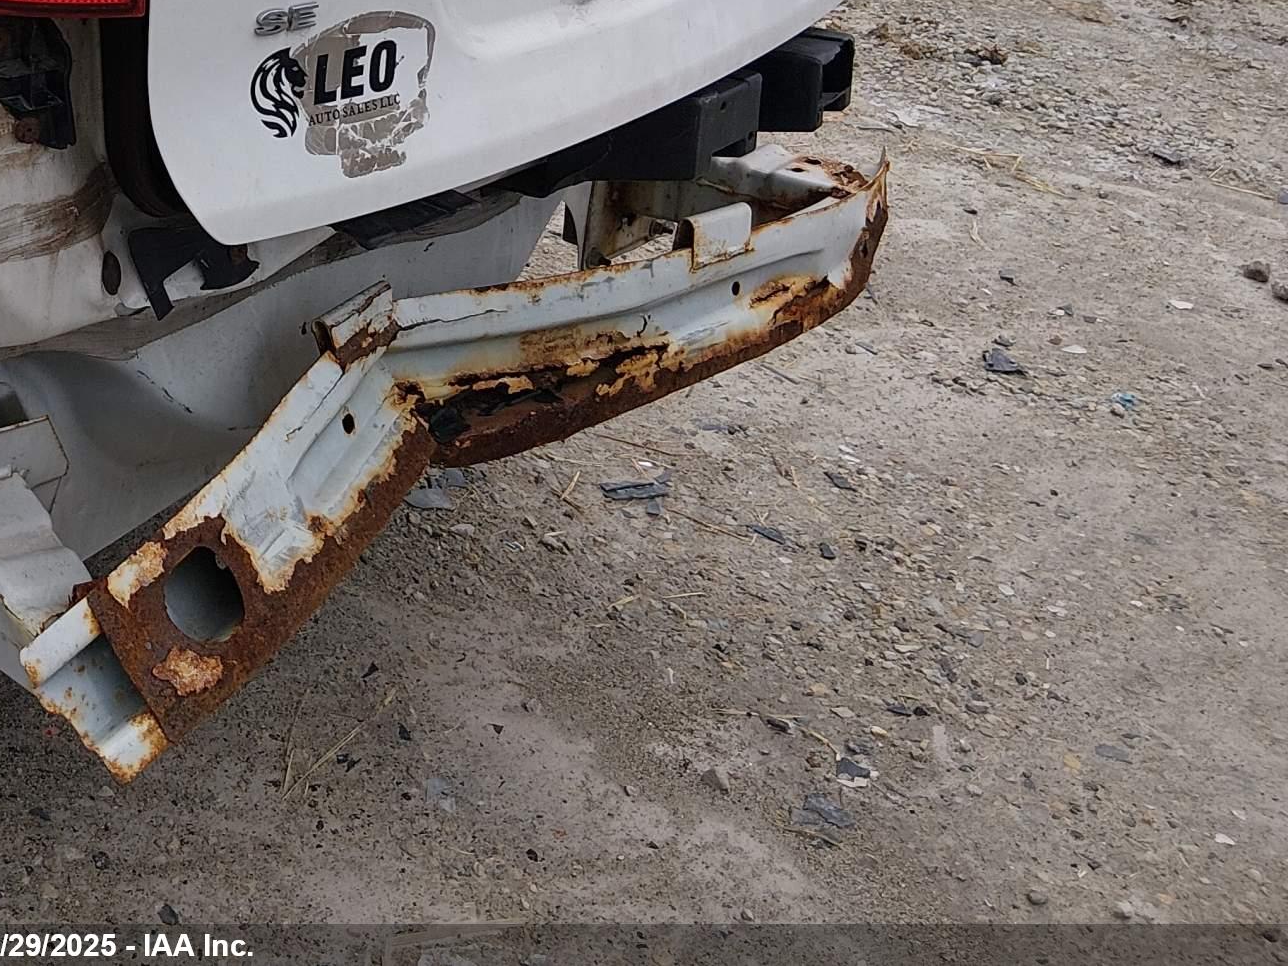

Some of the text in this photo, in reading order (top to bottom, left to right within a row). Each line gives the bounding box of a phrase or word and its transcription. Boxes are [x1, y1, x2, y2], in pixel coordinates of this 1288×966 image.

[253, 1, 320, 36] SE
[313, 39, 398, 106] LEO
[308, 93, 401, 127] AUTO SALES LLC
